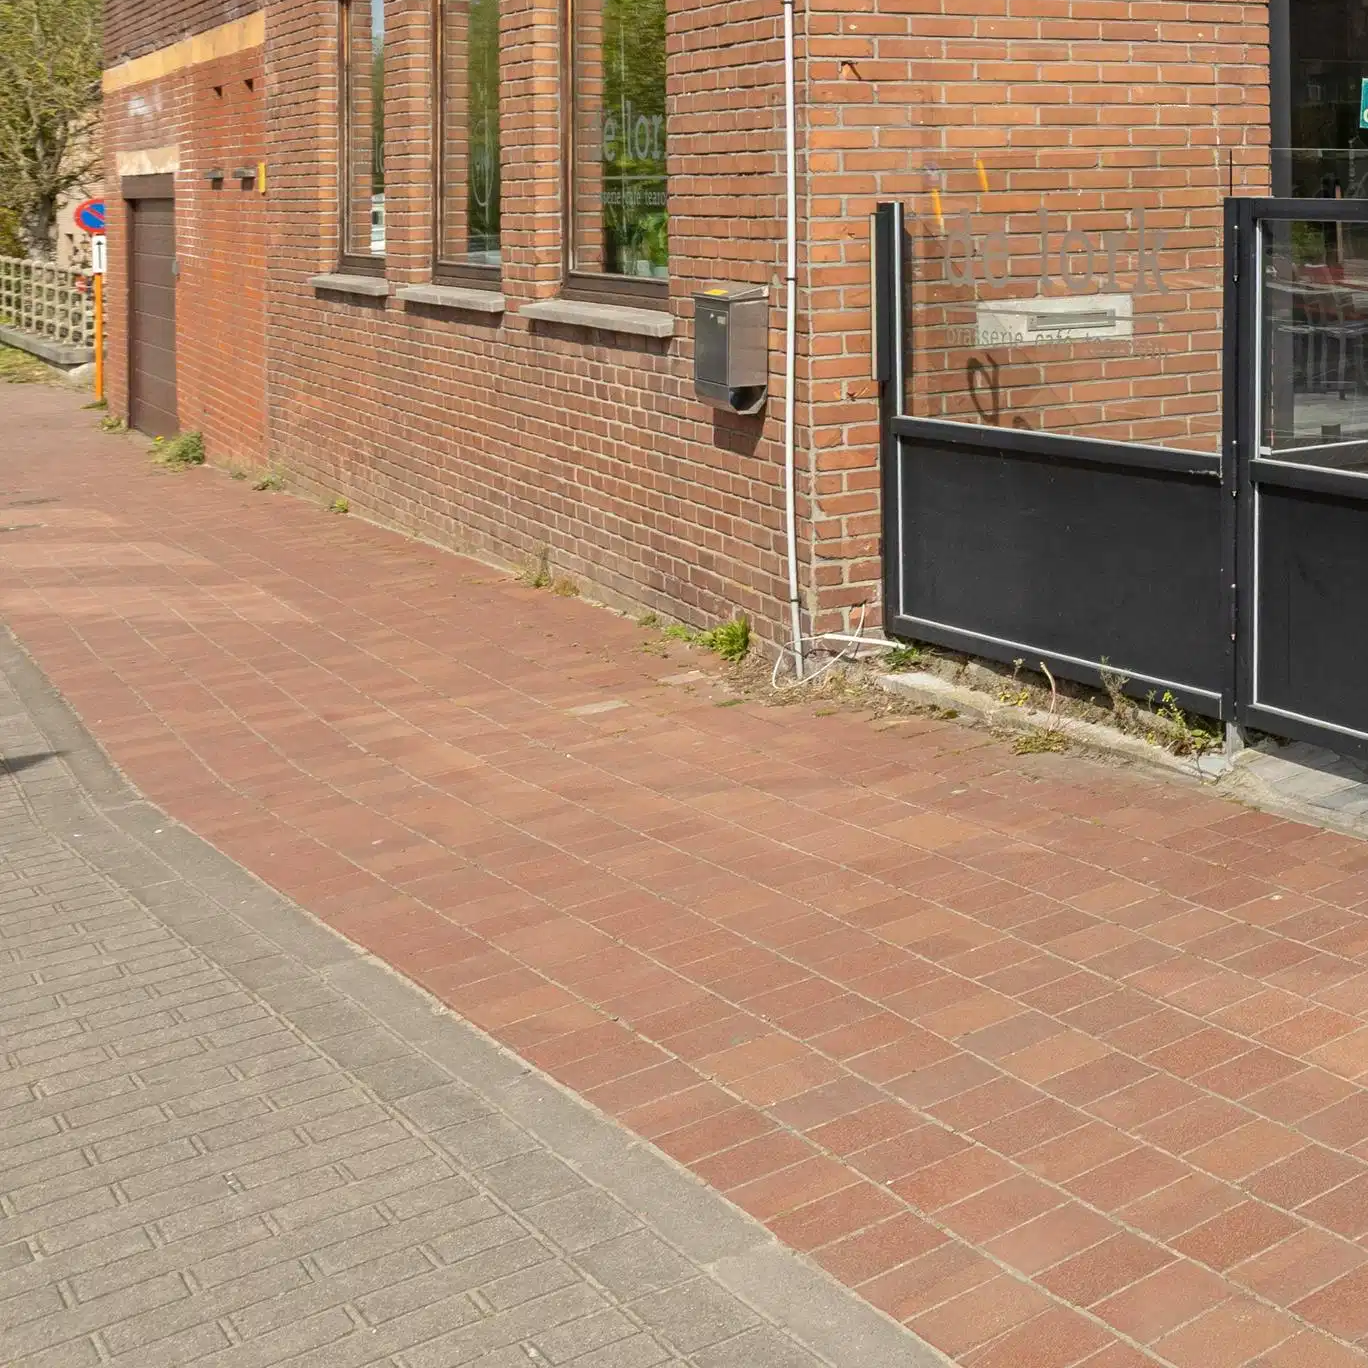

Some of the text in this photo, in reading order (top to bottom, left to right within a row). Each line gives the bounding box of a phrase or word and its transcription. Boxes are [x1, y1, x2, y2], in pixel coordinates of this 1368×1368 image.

[625, 99, 664, 161] lor
[945, 207, 1170, 295] de lork
